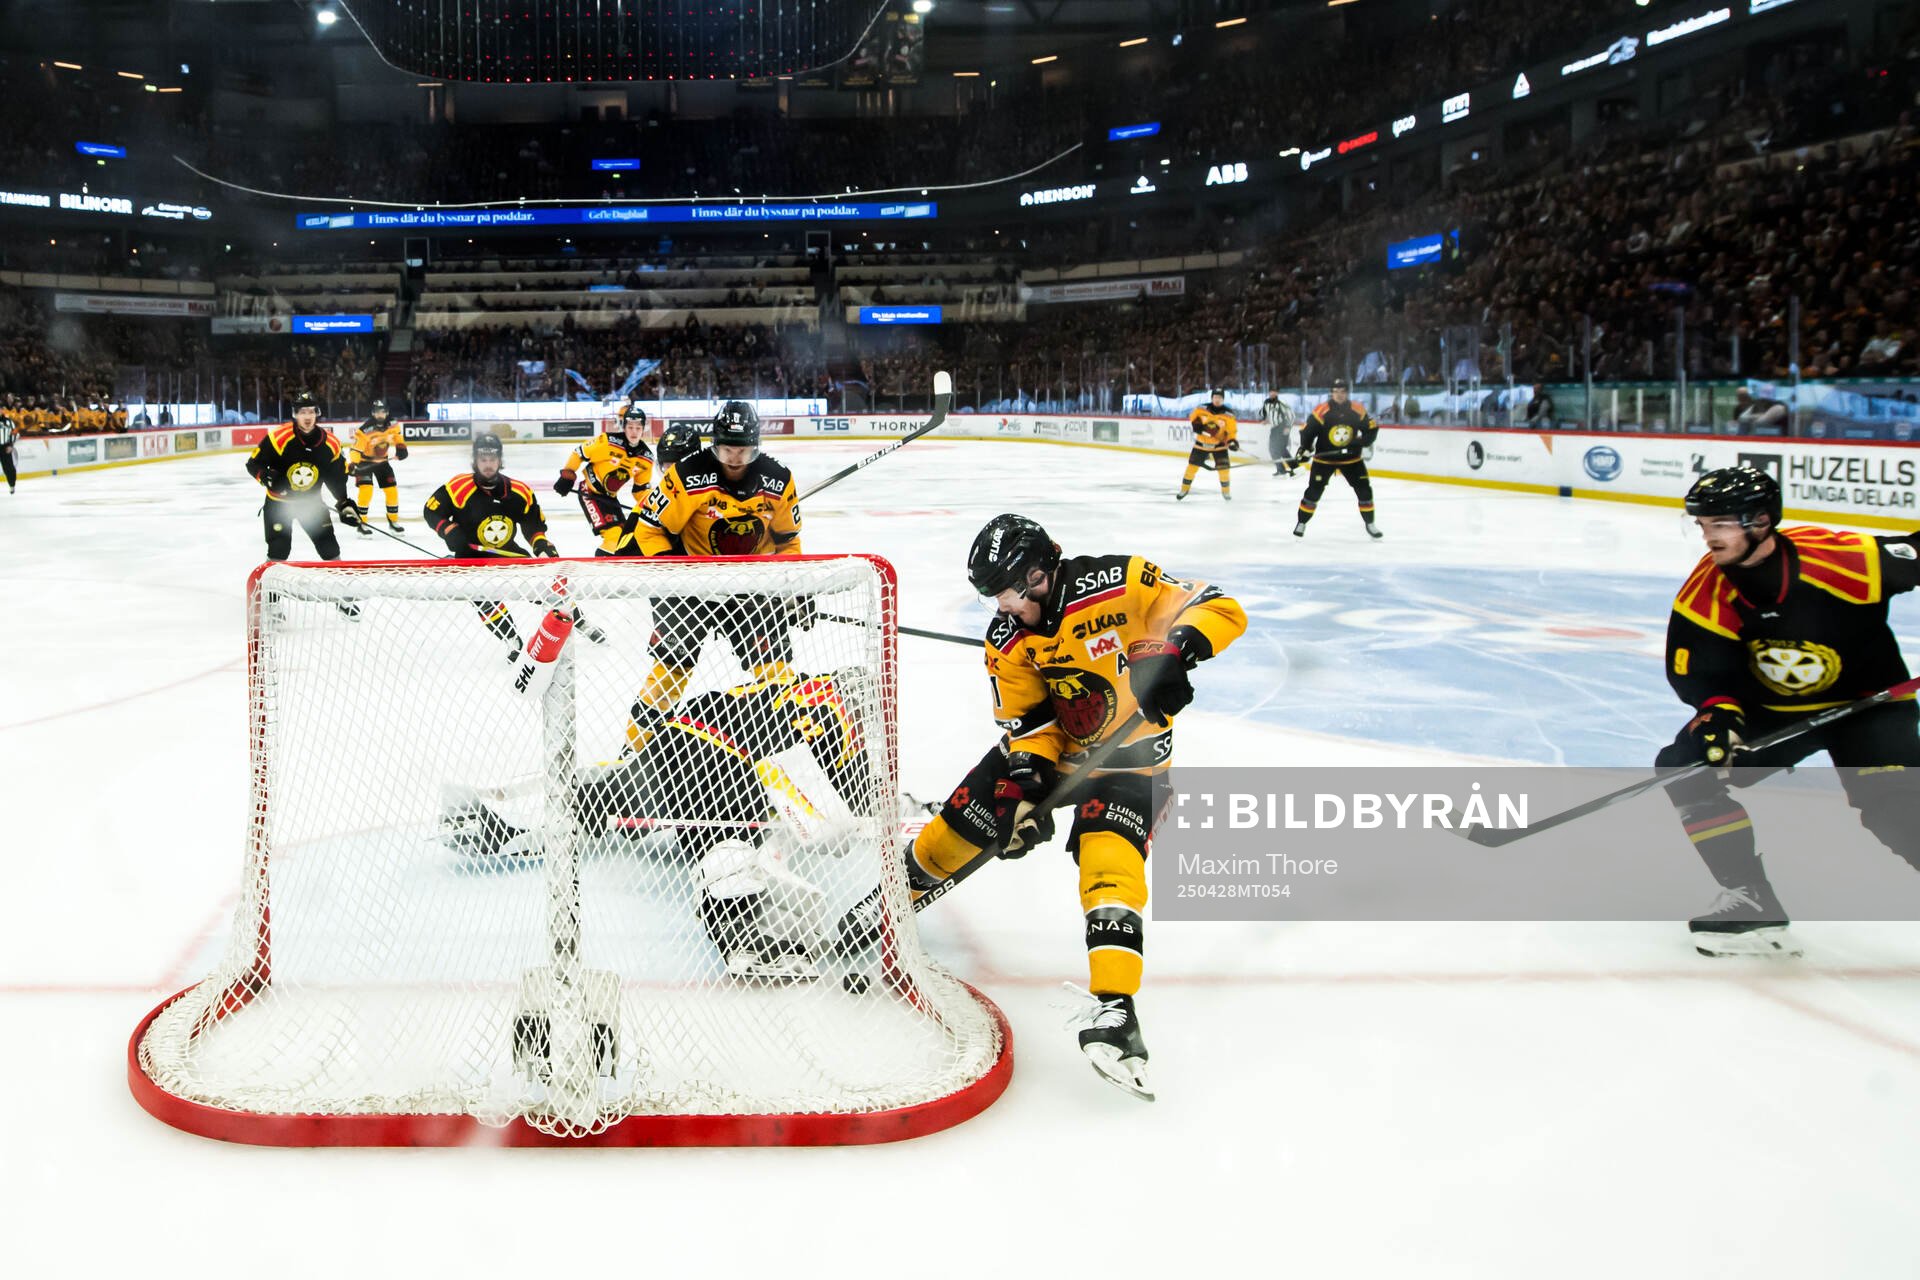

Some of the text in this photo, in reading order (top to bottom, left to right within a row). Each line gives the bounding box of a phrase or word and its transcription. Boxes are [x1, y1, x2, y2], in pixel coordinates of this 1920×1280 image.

[1206, 162, 1248, 186] ABB
[421, 213, 435, 223] du
[744, 207, 760, 217] du
[405, 426, 470, 438] DIVELLO
[811, 418, 849, 431] TSG
[686, 472, 718, 488] SSAB
[1790, 455, 1915, 486] HUZELLS
[760, 474, 785, 492] SAB
[647, 486, 670, 516] 24
[1790, 483, 1915, 508] TUNGA DELAR
[1075, 566, 1123, 595] SSAB
[991, 614, 1017, 646] SSA
[1087, 612, 1128, 635] LKAB
[1090, 637, 1118, 658] MAX
[514, 663, 536, 694] SHL
[1108, 802, 1144, 824] Luleå
[913, 878, 956, 913] AUER
